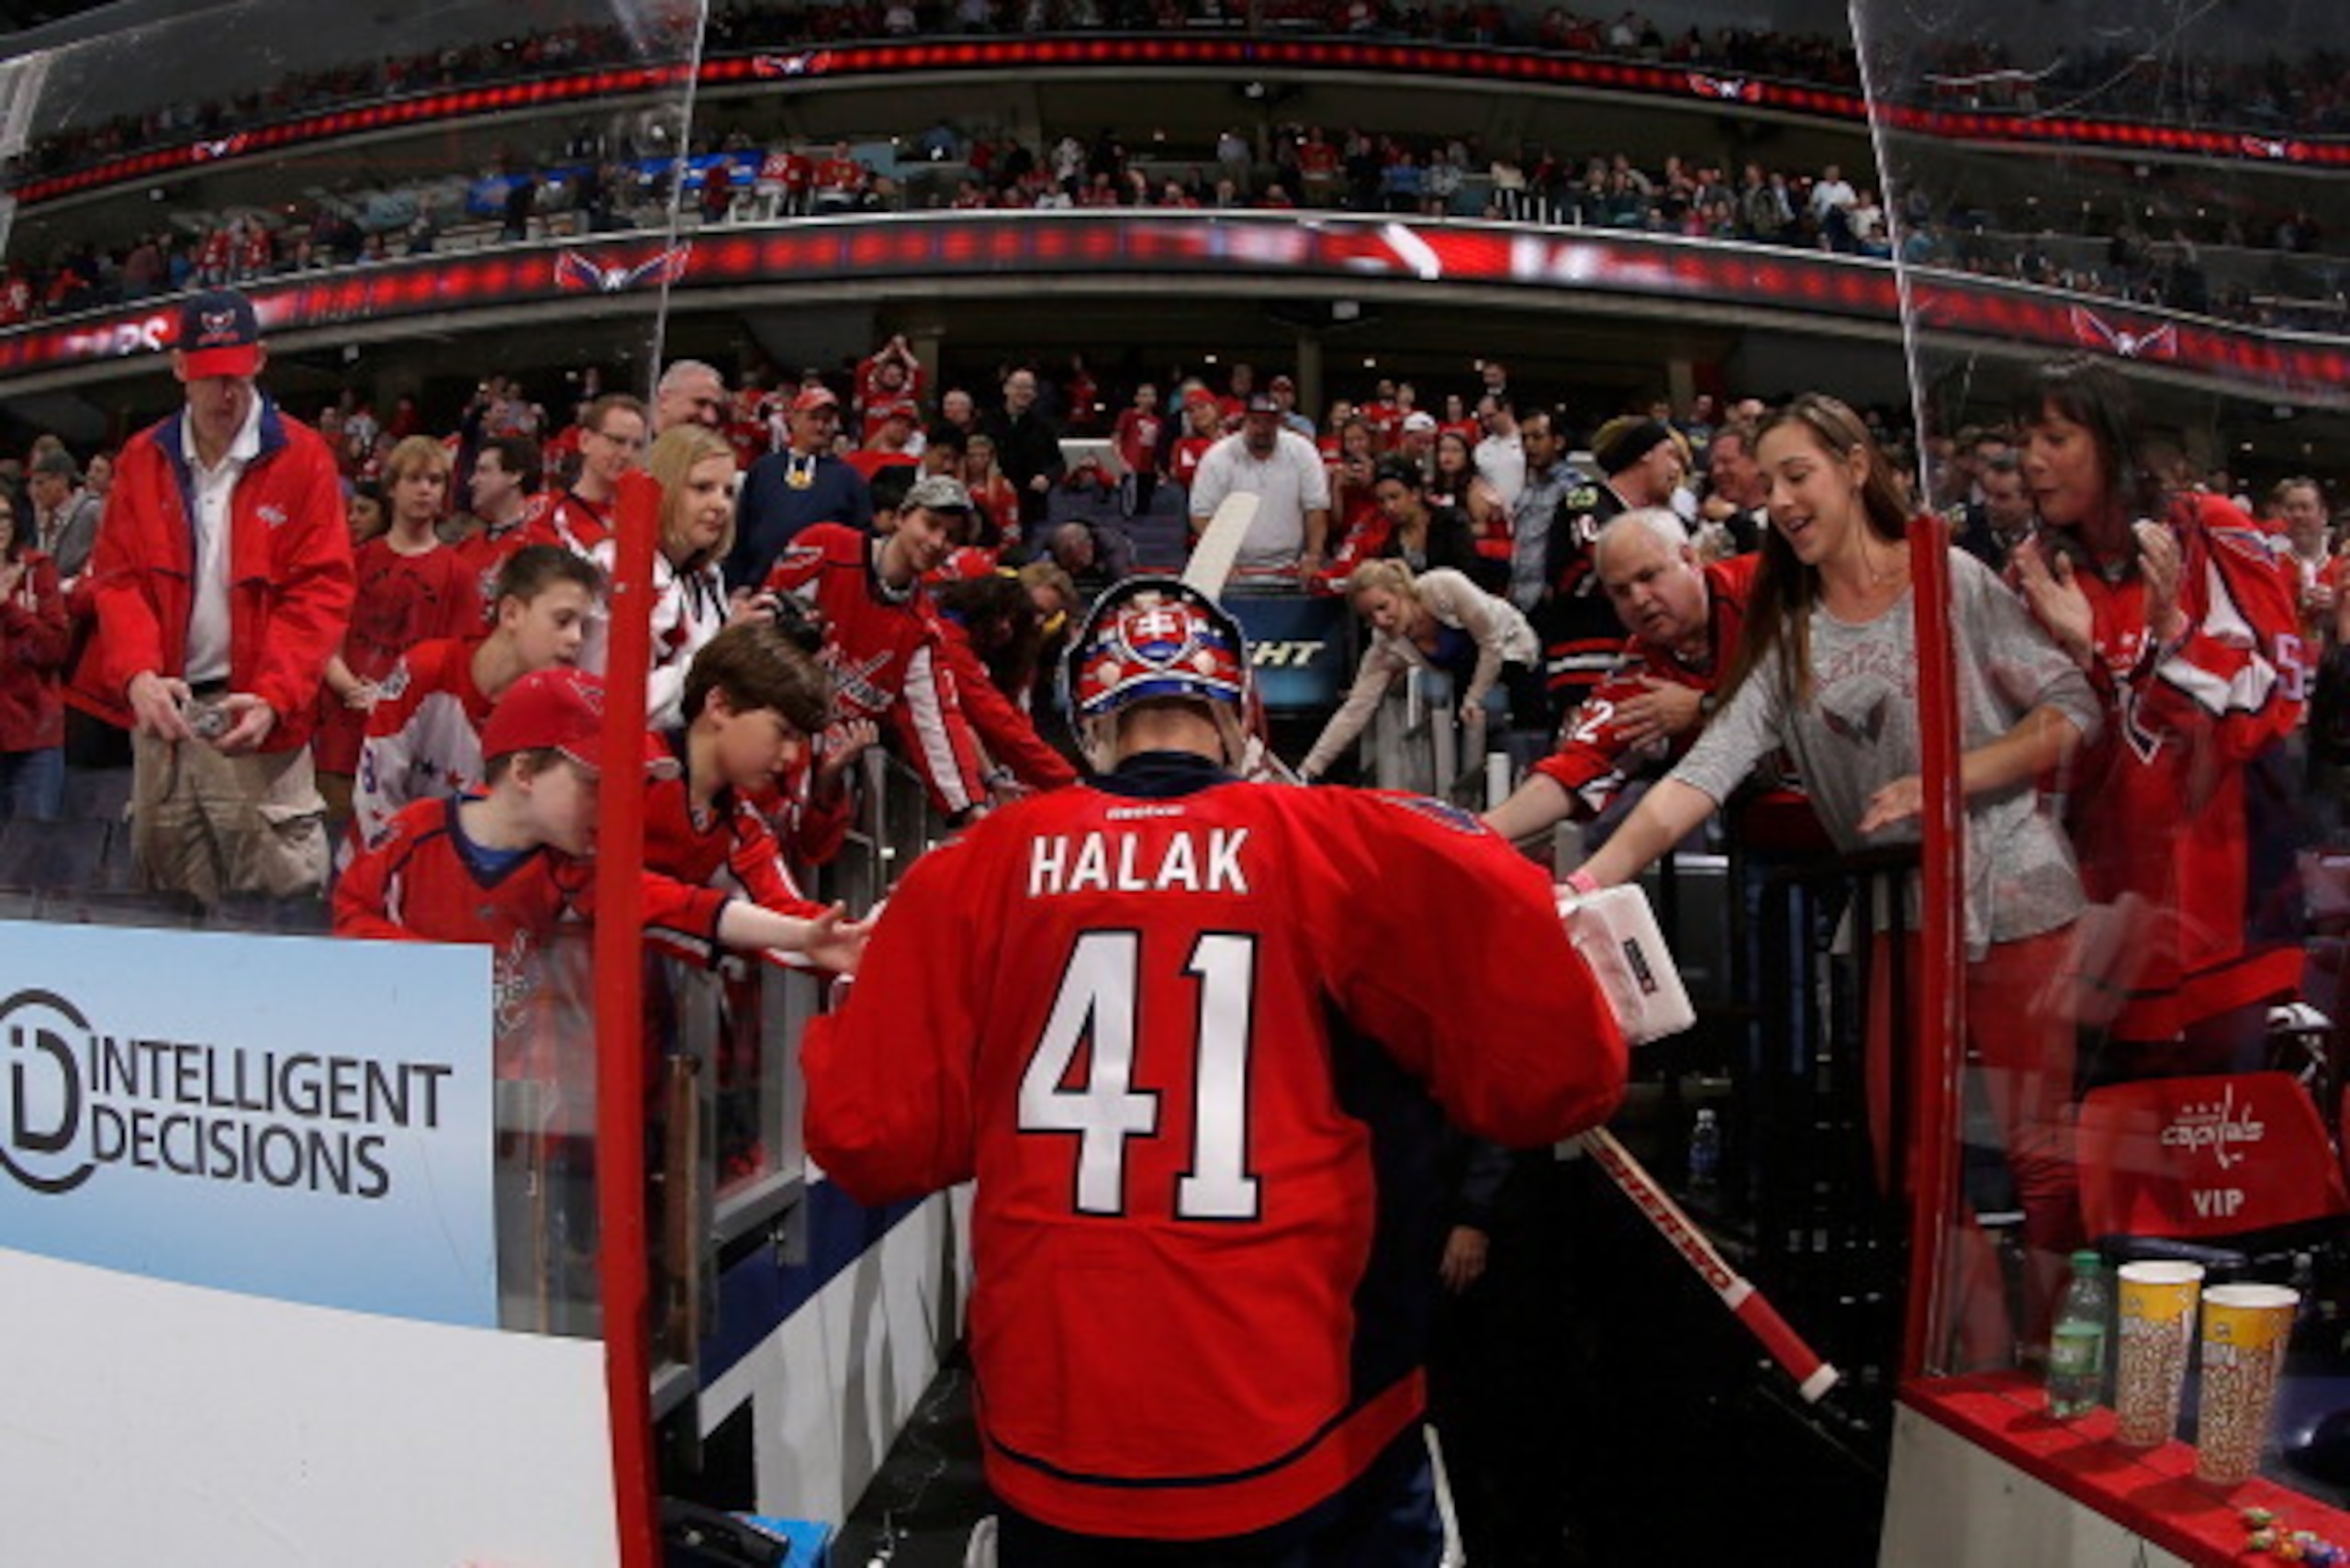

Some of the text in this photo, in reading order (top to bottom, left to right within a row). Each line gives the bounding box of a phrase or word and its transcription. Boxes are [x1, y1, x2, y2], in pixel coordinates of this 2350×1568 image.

[1247, 641, 1326, 666] HT
[1026, 827, 1249, 898] HALAK
[91, 1035, 453, 1128] INTELLIGENT
[1017, 927, 1260, 1222] 41
[91, 1103, 390, 1199] DECISIONS
[2190, 1188, 2245, 1217] VIP
